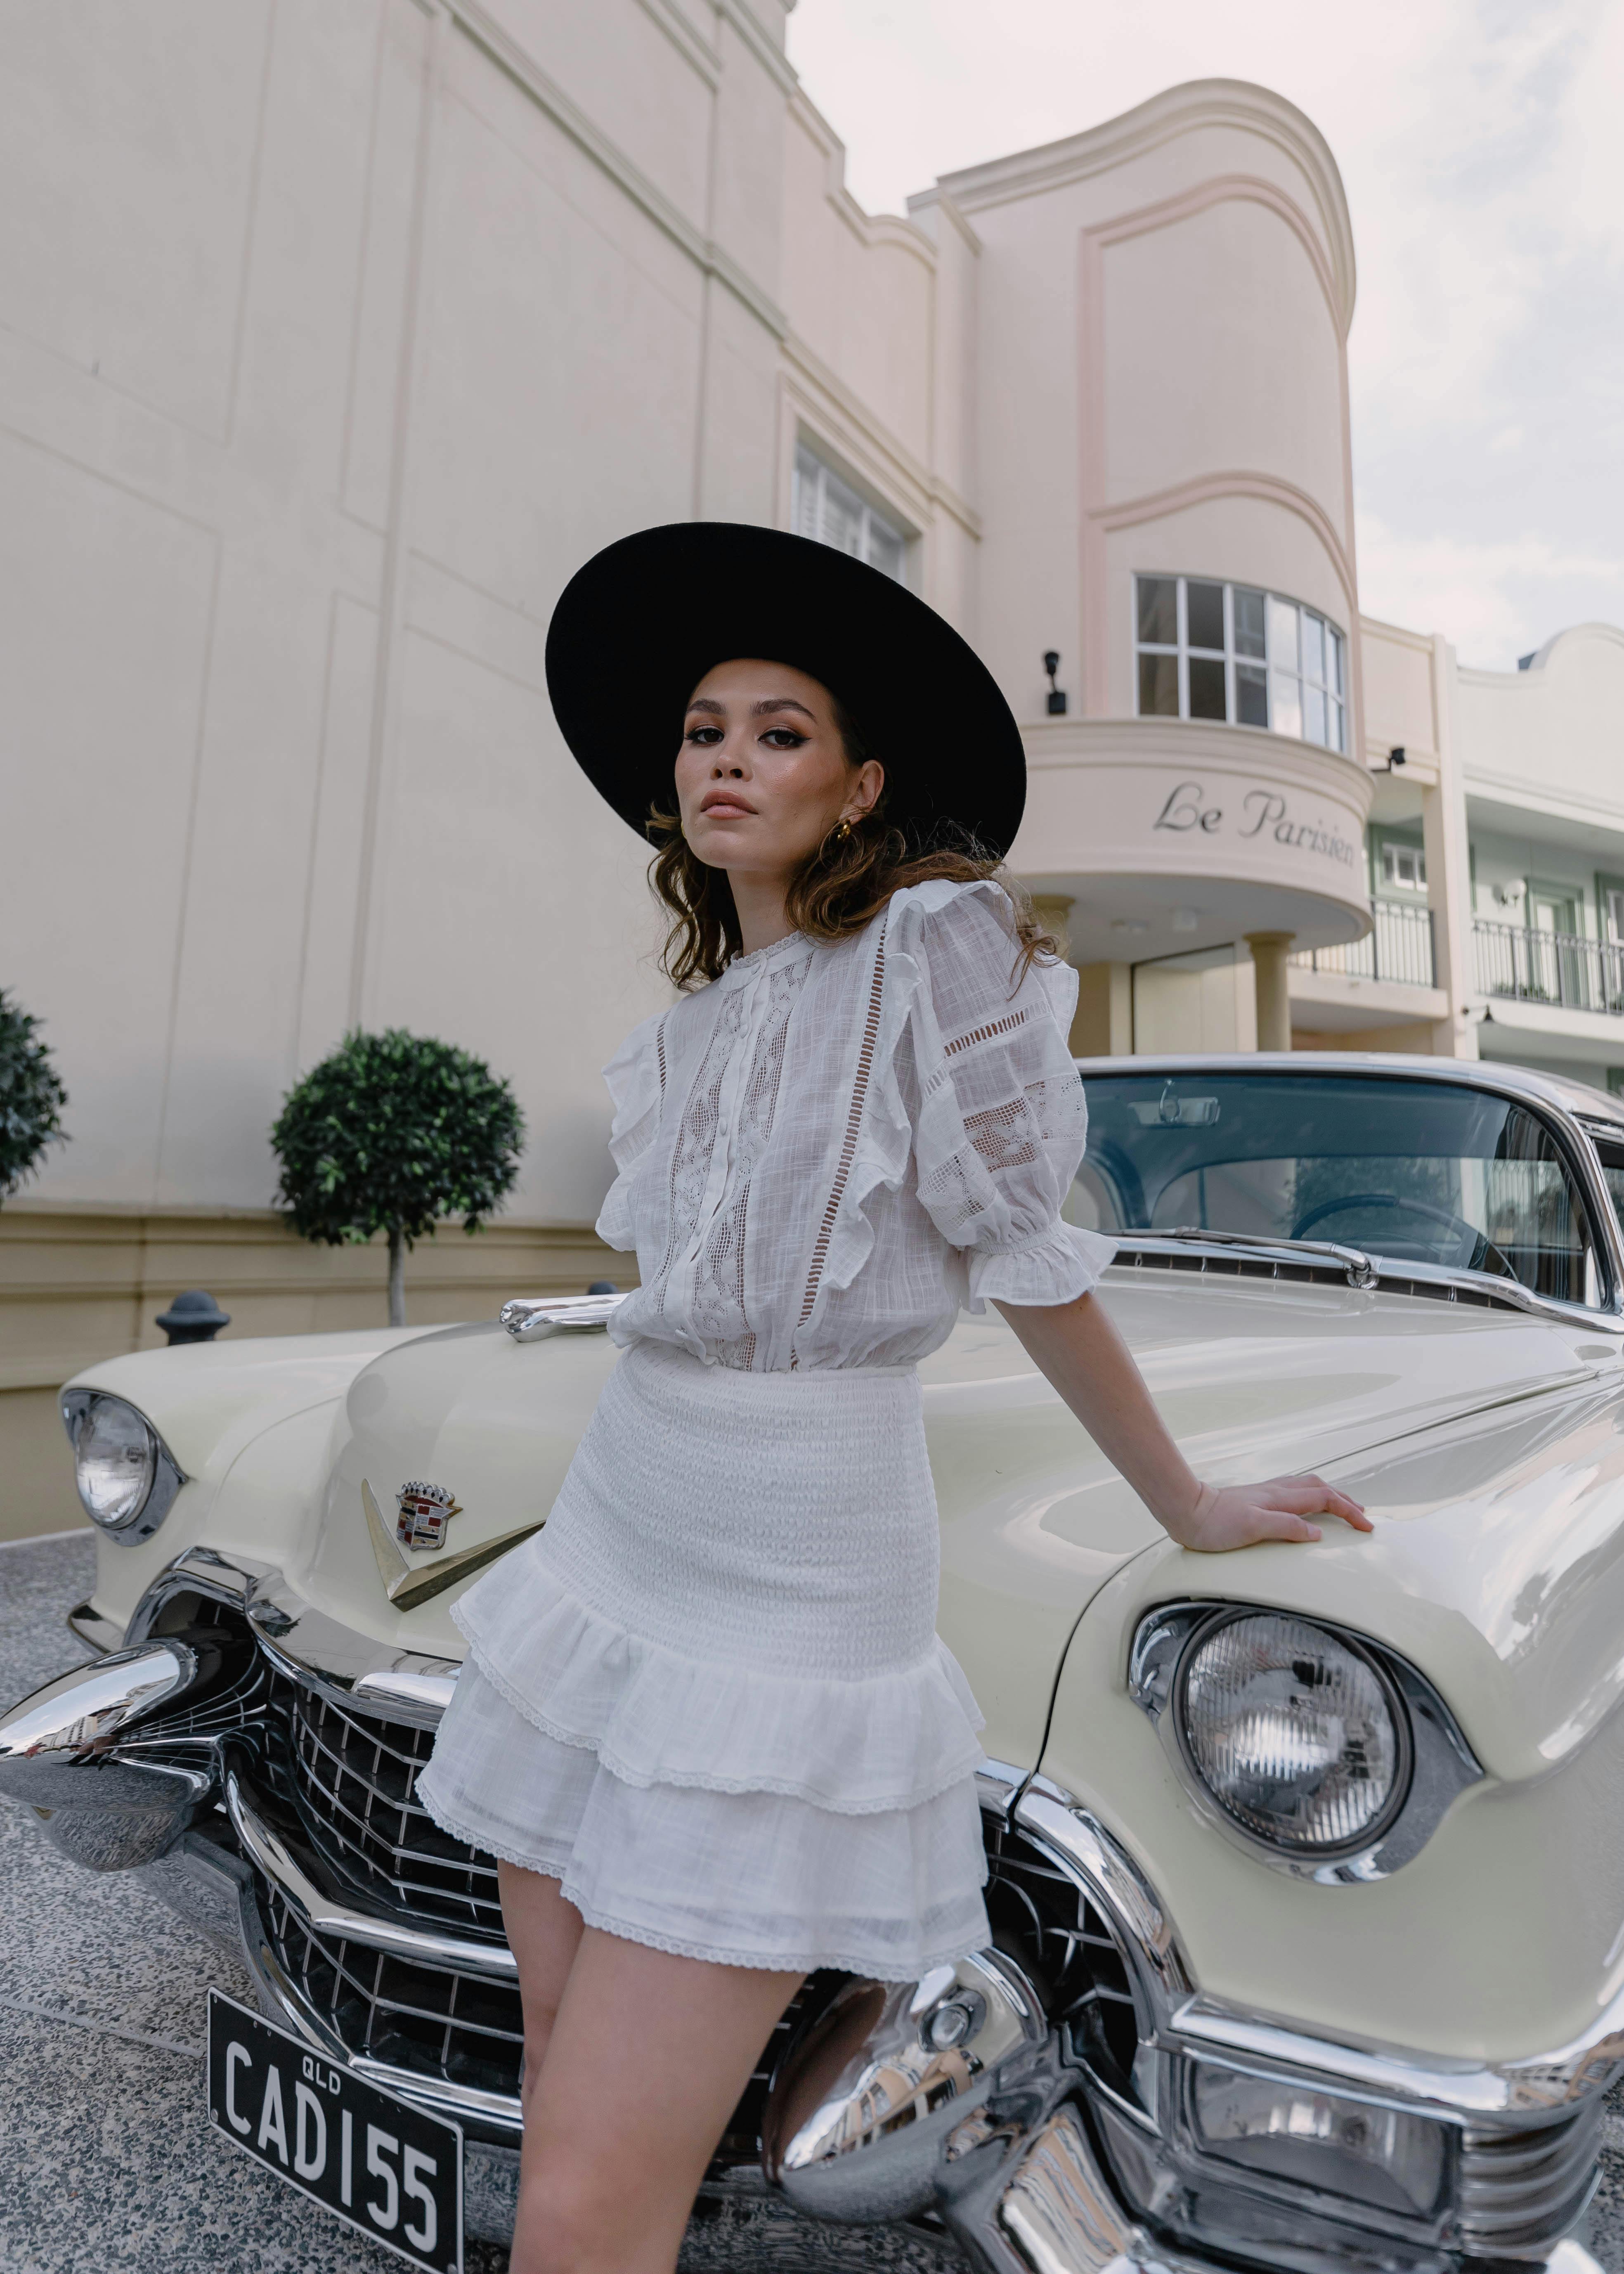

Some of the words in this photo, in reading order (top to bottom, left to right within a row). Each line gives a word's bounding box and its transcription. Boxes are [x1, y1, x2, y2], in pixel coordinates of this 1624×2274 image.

[1152, 782, 1222, 834] Le
[1238, 790, 1354, 868] Parisien
[303, 2056, 341, 2095] QLD
